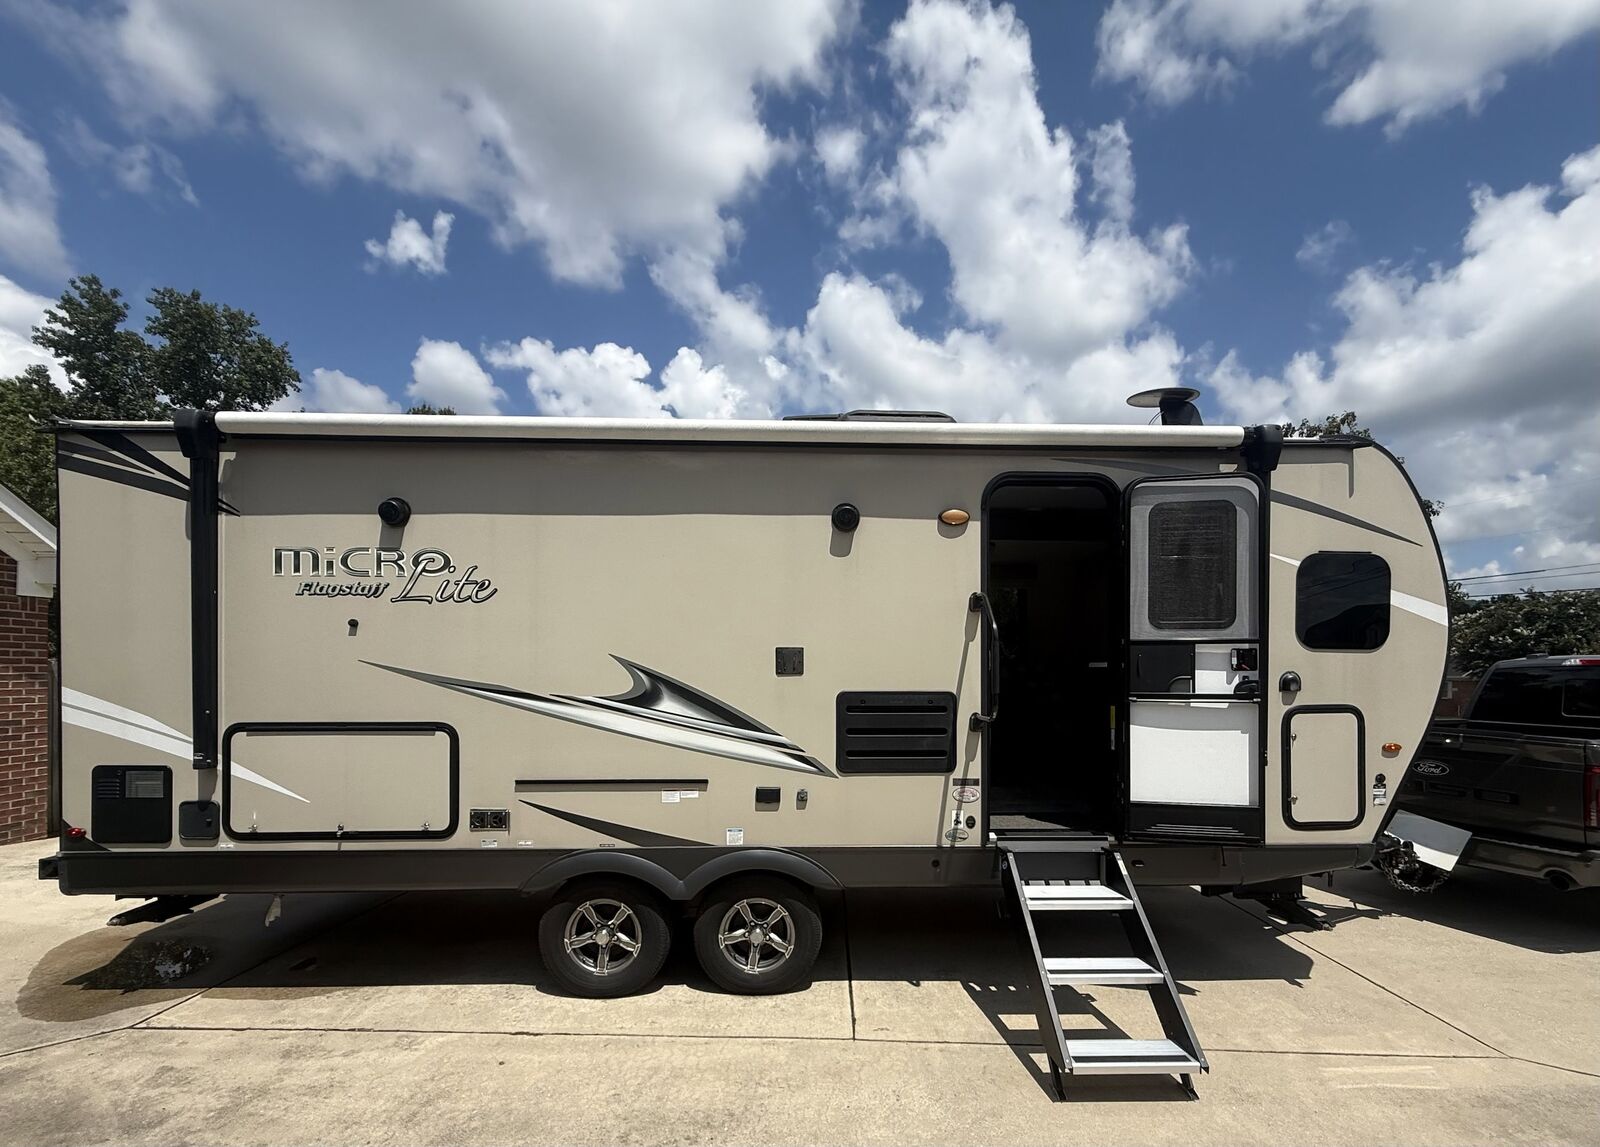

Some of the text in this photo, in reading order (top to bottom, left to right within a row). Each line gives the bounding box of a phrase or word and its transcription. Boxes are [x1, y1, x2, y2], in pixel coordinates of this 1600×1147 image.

[296, 581, 390, 598] Flagstaff
[390, 558, 497, 604] Lite
[1417, 763, 1442, 774] Ford
